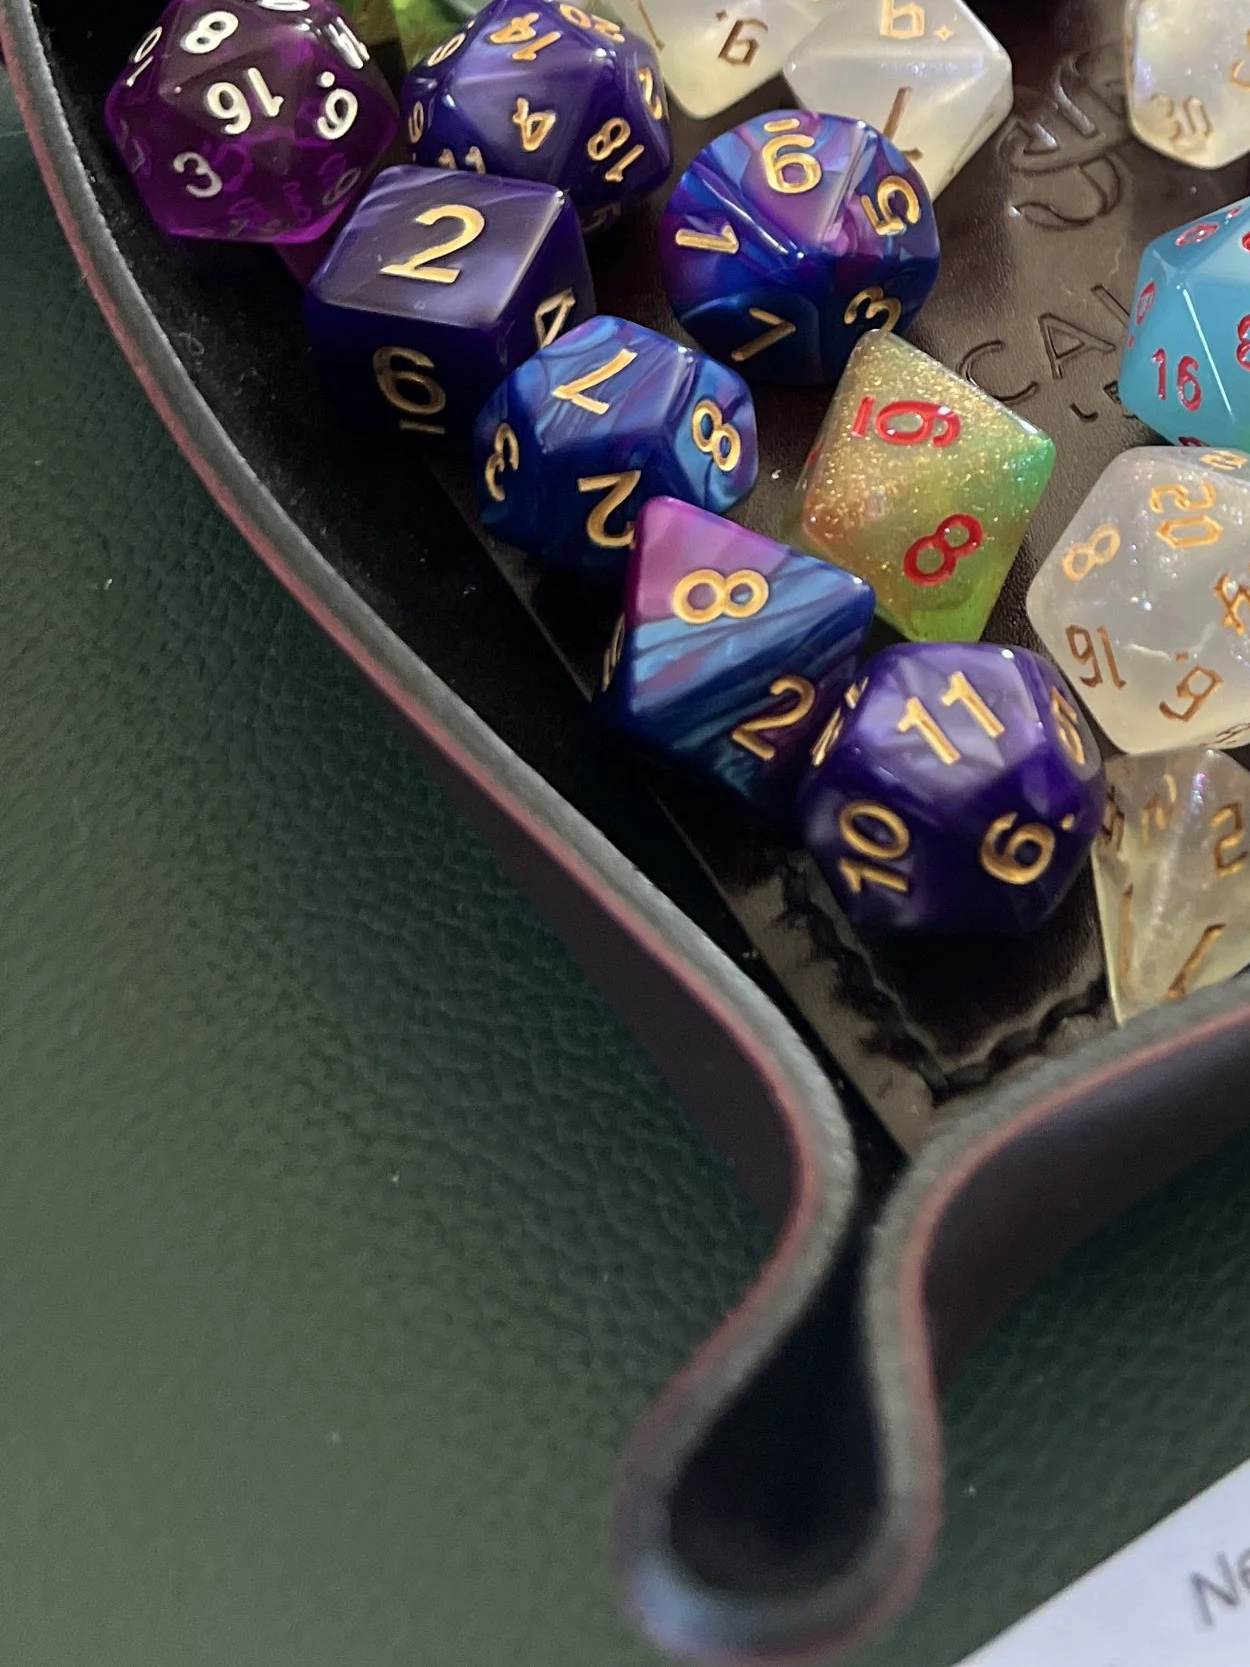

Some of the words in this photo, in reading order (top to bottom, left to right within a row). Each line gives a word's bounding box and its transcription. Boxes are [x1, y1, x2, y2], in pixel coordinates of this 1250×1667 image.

[180, 10, 240, 54] 8
[490, 12, 562, 61] 14
[512, 97, 556, 152] 4
[587, 116, 645, 183] 18
[172, 151, 223, 199] 3
[860, 174, 921, 236] 5
[380, 203, 486, 285] 2
[674, 223, 740, 255] 1
[533, 287, 577, 351] 4
[731, 307, 798, 363] 7
[843, 285, 902, 333] 3
[552, 348, 639, 416] 7
[1151, 347, 1204, 413] 16
[484, 421, 520, 503] 3
[690, 398, 742, 472] 8
[576, 468, 642, 549] 2
[1147, 481, 1225, 540] 20
[904, 512, 985, 588] 8
[1060, 523, 1121, 583] 8
[671, 568, 770, 625] 8
[730, 673, 816, 761] 2
[896, 669, 1007, 766] 11
[838, 799, 911, 895] 10
